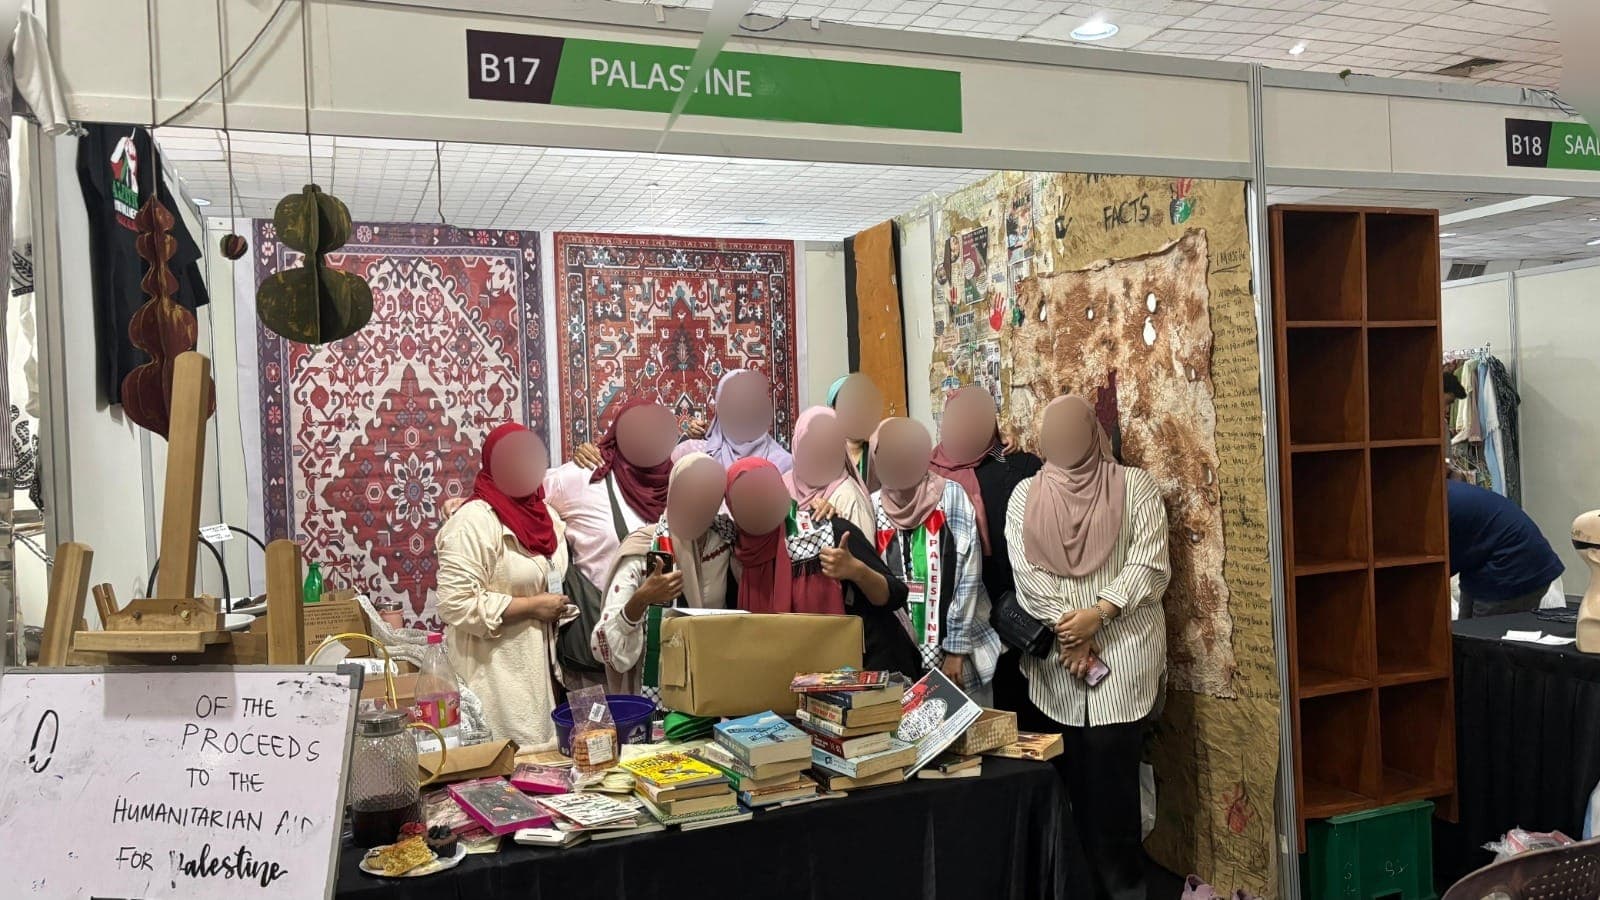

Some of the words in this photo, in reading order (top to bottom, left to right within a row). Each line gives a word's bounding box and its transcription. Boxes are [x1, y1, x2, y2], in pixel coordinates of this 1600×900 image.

[479, 53, 540, 85] B17
[590, 57, 752, 97] PALASINE
[1511, 134, 1542, 156] B18
[1103, 192, 1151, 232] FACTS
[927, 539, 938, 644] PALESTINE
[196, 695, 229, 719] OF
[242, 697, 278, 719] THE
[181, 723, 321, 762] PROCEEDS
[186, 768, 210, 789] TO
[230, 771, 265, 792] THE
[112, 795, 263, 832] HUMANITARIAN
[115, 846, 154, 871] FOR
